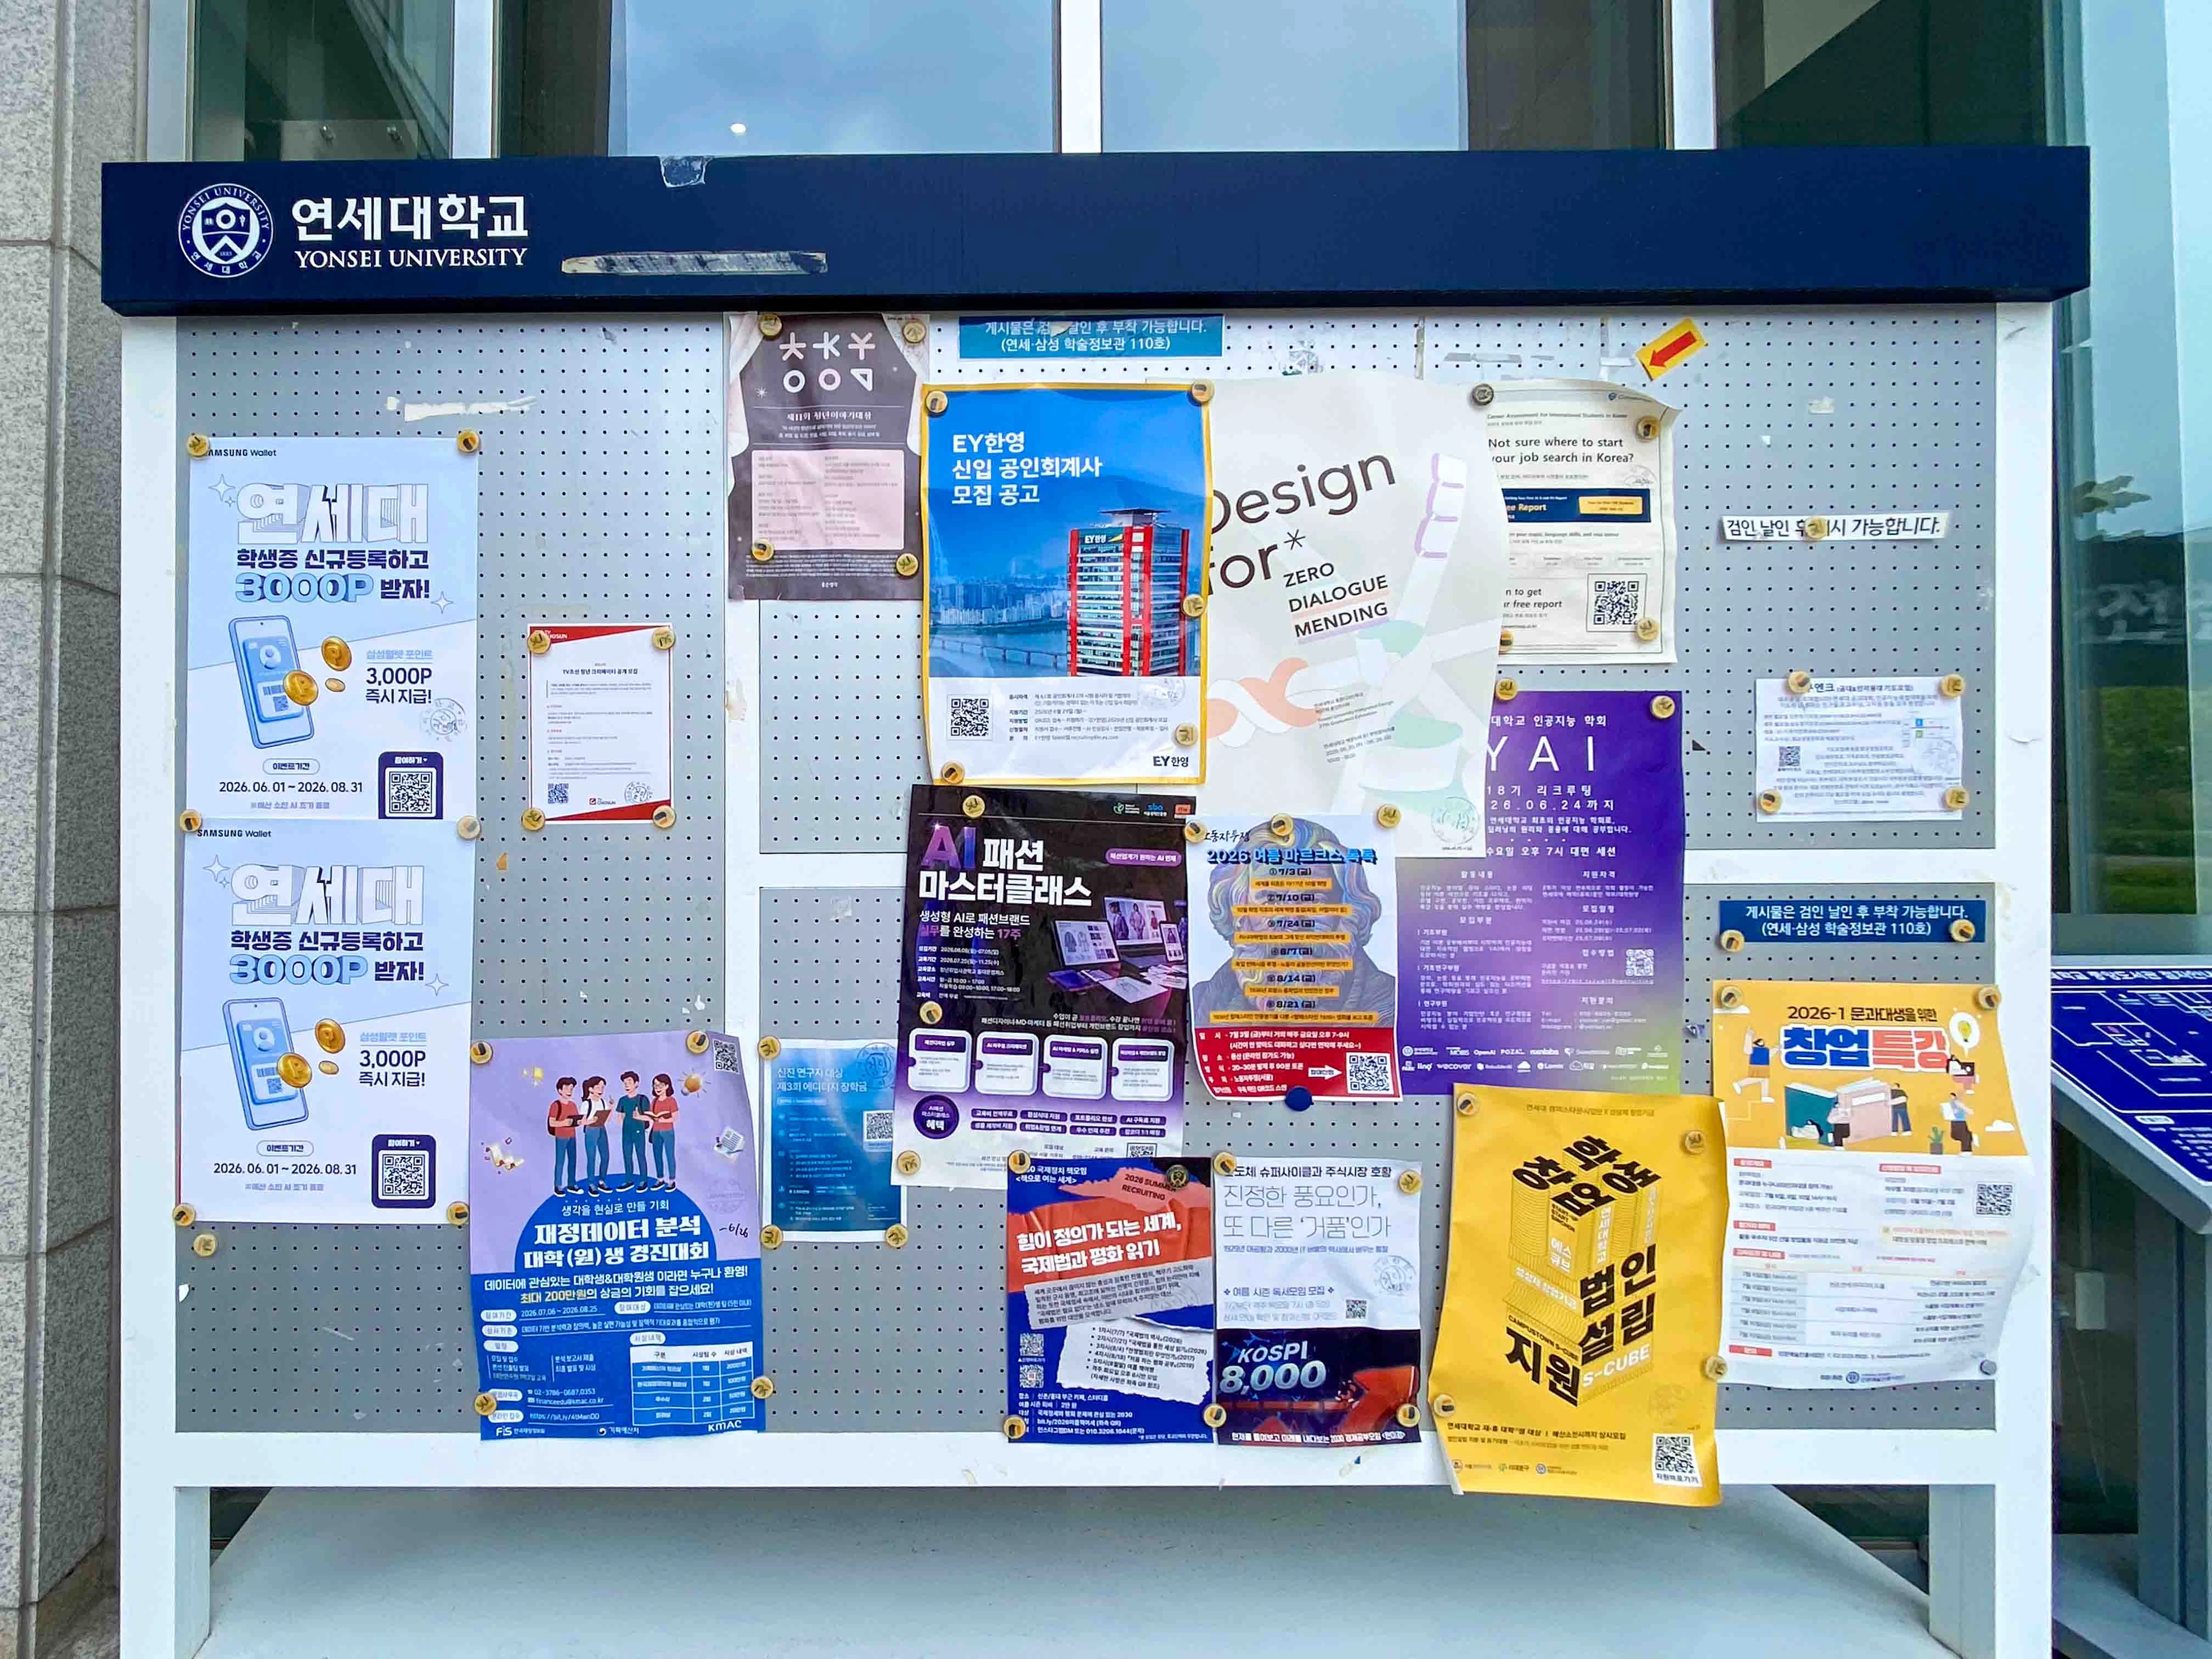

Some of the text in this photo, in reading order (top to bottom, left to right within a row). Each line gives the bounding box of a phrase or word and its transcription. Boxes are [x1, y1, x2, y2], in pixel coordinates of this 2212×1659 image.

[183, 187, 269, 230] YONSEI UNIVERSITY
[292, 194, 528, 241] 연세대학교
[295, 248, 527, 269] YONSEI UNIVERSITY
[985, 321, 1034, 335] 게시물은
[1097, 321, 1109, 334] 후
[1112, 320, 1136, 334] 부착
[1142, 321, 1206, 334] 가능합니다.
[1001, 337, 1170, 352] (연세·삼성 학술정보관 110호)
[953, 432, 1024, 453] EY한영
[1488, 439, 1510, 448] Not
[1545, 437, 1577, 447] where
[1598, 438, 1623, 447] start
[952, 456, 1103, 479] 신입 공인회계사
[1519, 453, 1538, 465] job
[1543, 453, 1577, 462] search
[1582, 453, 1592, 462] in
[1597, 453, 1634, 462] Korea?
[952, 484, 1039, 505] 모집 공고
[1212, 455, 1395, 534] Design
[236, 483, 429, 545] 연세대
[1519, 504, 1547, 512] Report
[1727, 520, 1755, 536] 검인
[1760, 518, 1789, 536] 날인
[1852, 517, 1939, 536] 가능합니다.
[1085, 534, 1106, 544] EY한영
[237, 549, 429, 569] 학생증 신규등록하고
[1207, 529, 1306, 595] or
[1283, 562, 1334, 588] ZERO
[235, 572, 430, 603] 3000P 받자!
[1289, 575, 1388, 612] DIALOGUE
[1527, 589, 1542, 597] get
[1514, 600, 1562, 610] free report
[1294, 603, 1388, 637] MENDING
[366, 667, 432, 686] 3,000P
[365, 689, 432, 704] 즉시 지급!
[1491, 715, 1606, 727] 대학교 인공지능 학회
[273, 762, 310, 771] 이벤트기간
[1153, 757, 1189, 766] EY한영
[1537, 785, 1592, 796] 리크루팅
[245, 830, 272, 838] Wallet
[921, 823, 1044, 871] AI 패션
[1207, 850, 1251, 864] 2026
[1254, 849, 1283, 864] 여름
[1285, 849, 1344, 864] 마르크스
[918, 870, 1092, 906] 마스터클래스
[919, 911, 1030, 926] 생성형 AI로 패션브랜드
[1746, 906, 1968, 919] 게시물은 검인 날인 후 부착 가능합니다.
[953, 927, 995, 939] 완성하는
[1762, 921, 1931, 936] (연세·삼성 학술정보관 110호)
[1788, 1006, 1937, 1022] 2026-1 문과대생을 위한
[1784, 1028, 1948, 1068] 창업특강
[359, 1050, 426, 1068] 3,000P
[777, 1068, 843, 1078] 신진 연구자 대상
[926, 1120, 944, 1131] 혜택
[1037, 1166, 1087, 1175] 국제정치 책모임
[1224, 1166, 1256, 1177] 도체
[1260, 1166, 1322, 1177] 슈퍼사이클과
[1325, 1166, 1367, 1177] 주식시장
[1122, 1184, 1165, 1200] RECRUITING
[1223, 1185, 1381, 1208] 진정한 풍요인가,
[561, 1200, 669, 1216] 생각을 현실로 만들 기회
[534, 1216, 701, 1245] 재정데이터 분석
[1017, 1211, 1181, 1251] 힘이 정의가 되는 세계,
[1223, 1216, 1244, 1237] 또
[1251, 1216, 1294, 1238] 다른
[523, 1242, 709, 1269] 대학(원)생 경진대회
[1022, 1239, 1160, 1274] 국제법과 평화 읽기
[484, 1266, 747, 1291] 데이터에 관심있는 대학생&대학원생 이라면 누구나 환영!
[521, 1308, 555, 1317] 2026.07.06
[563, 1306, 597, 1315] 2026.08.25
[1509, 1315, 1578, 1361] CAMPUSTOWN S-CUBE
[1238, 1340, 1307, 1363] KOSPI
[1505, 1327, 1581, 1408] 지원
[1583, 1344, 1650, 1387] S-CUBE
[1220, 1361, 1326, 1395] 8,000
[496, 1425, 512, 1436] FIS
[708, 1420, 742, 1432] KMAC
